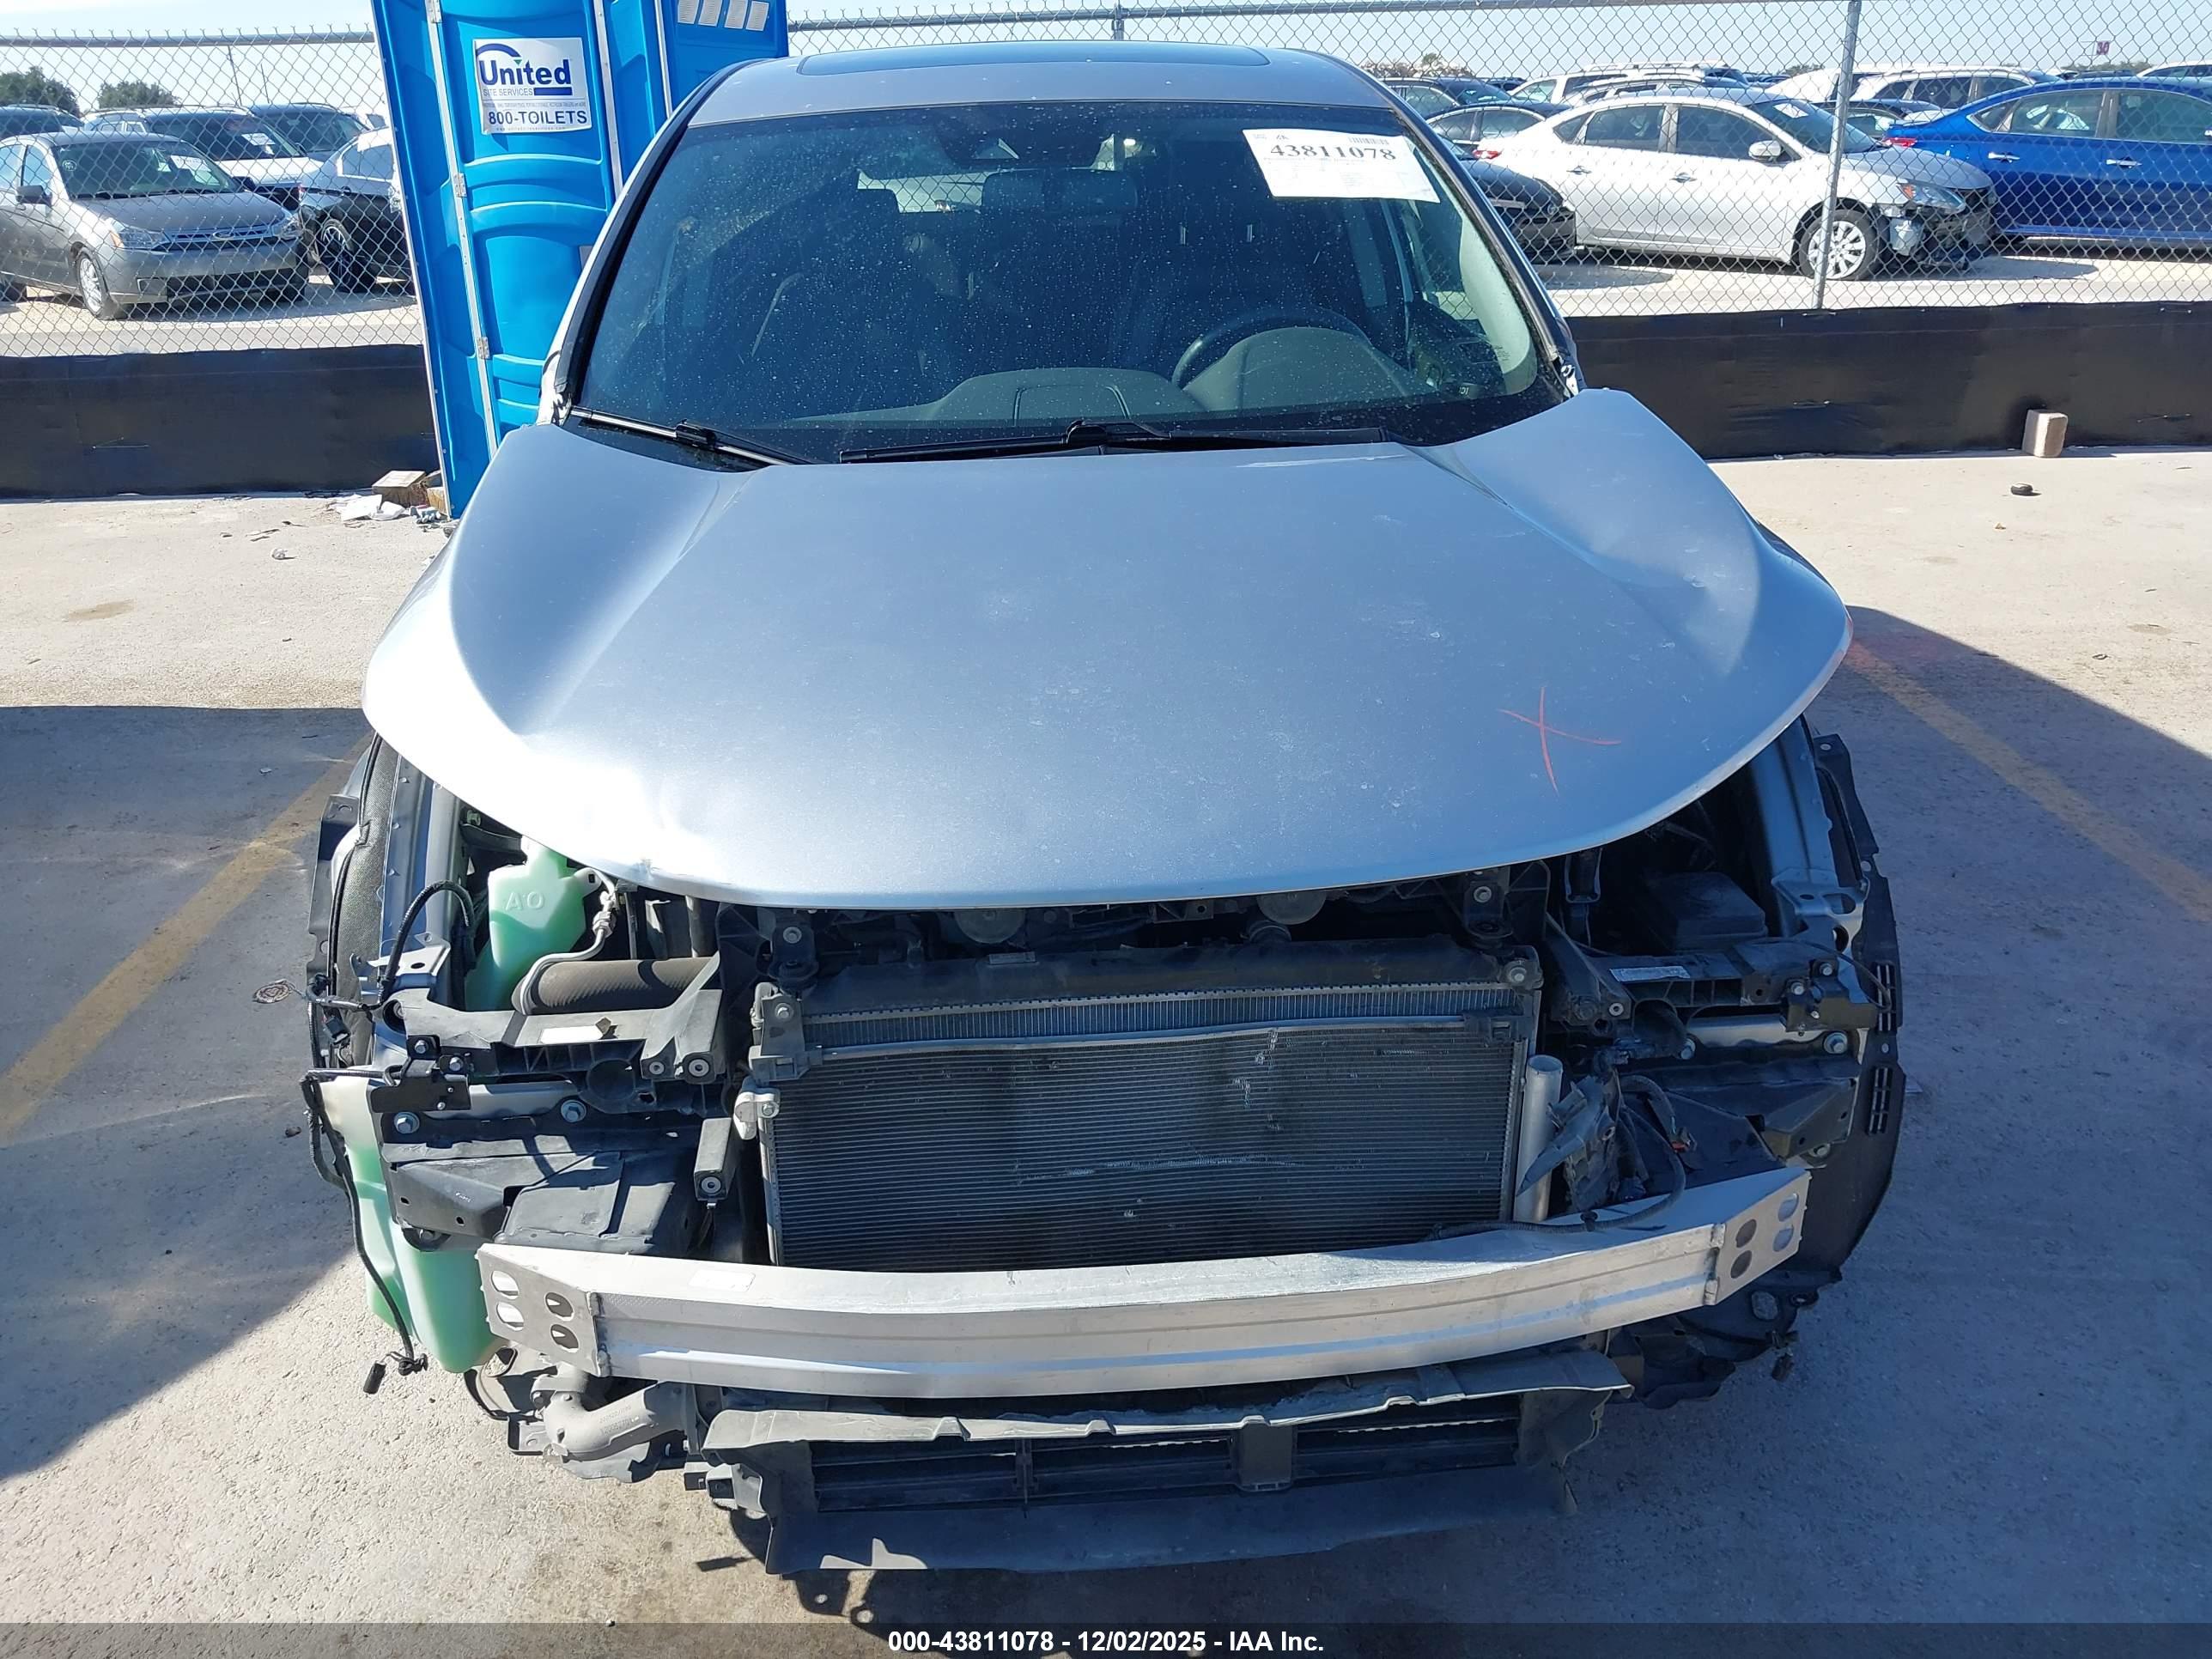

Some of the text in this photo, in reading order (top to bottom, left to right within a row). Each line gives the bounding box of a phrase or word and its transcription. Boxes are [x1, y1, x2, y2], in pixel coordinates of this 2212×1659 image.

[478, 58, 572, 86] United
[500, 88, 533, 96] SERVICES
[488, 110, 587, 125] 800-TOILETS
[1270, 144, 1397, 161] 43811078
